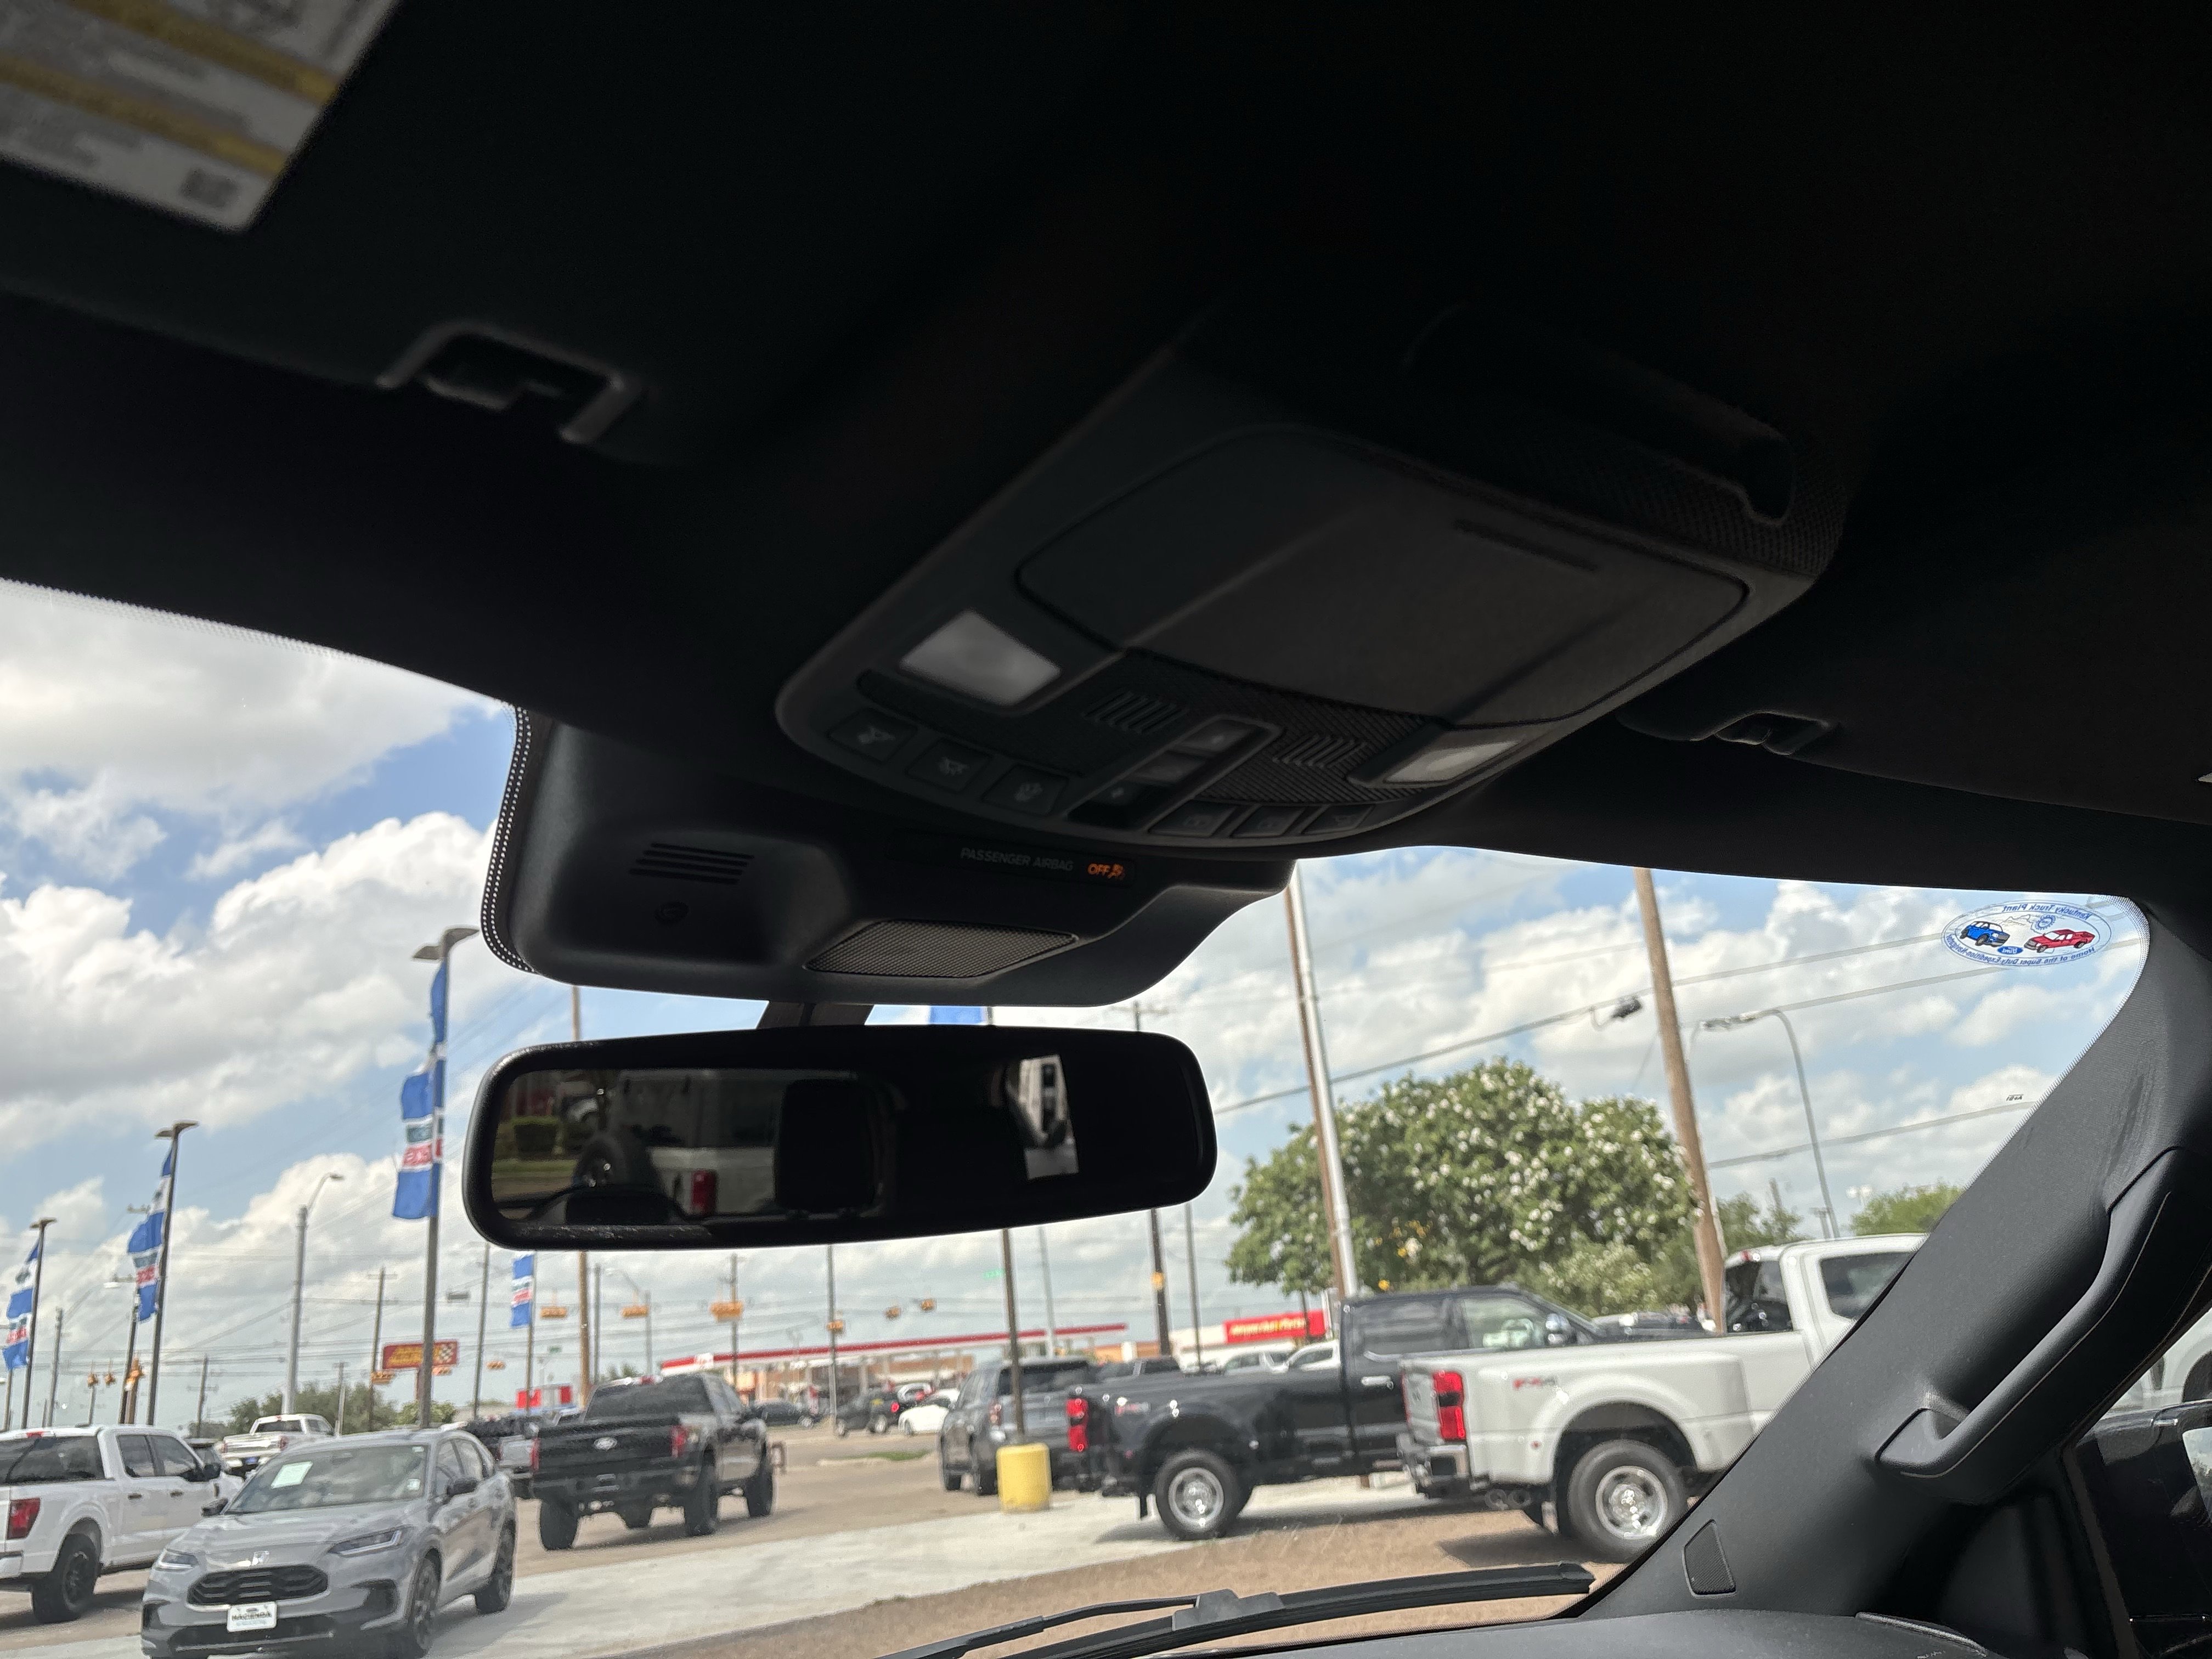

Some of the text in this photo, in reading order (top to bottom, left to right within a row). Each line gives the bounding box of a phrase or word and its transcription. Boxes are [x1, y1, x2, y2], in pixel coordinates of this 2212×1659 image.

[960, 847, 1110, 876] PASSENGER AIRBAG OFF
